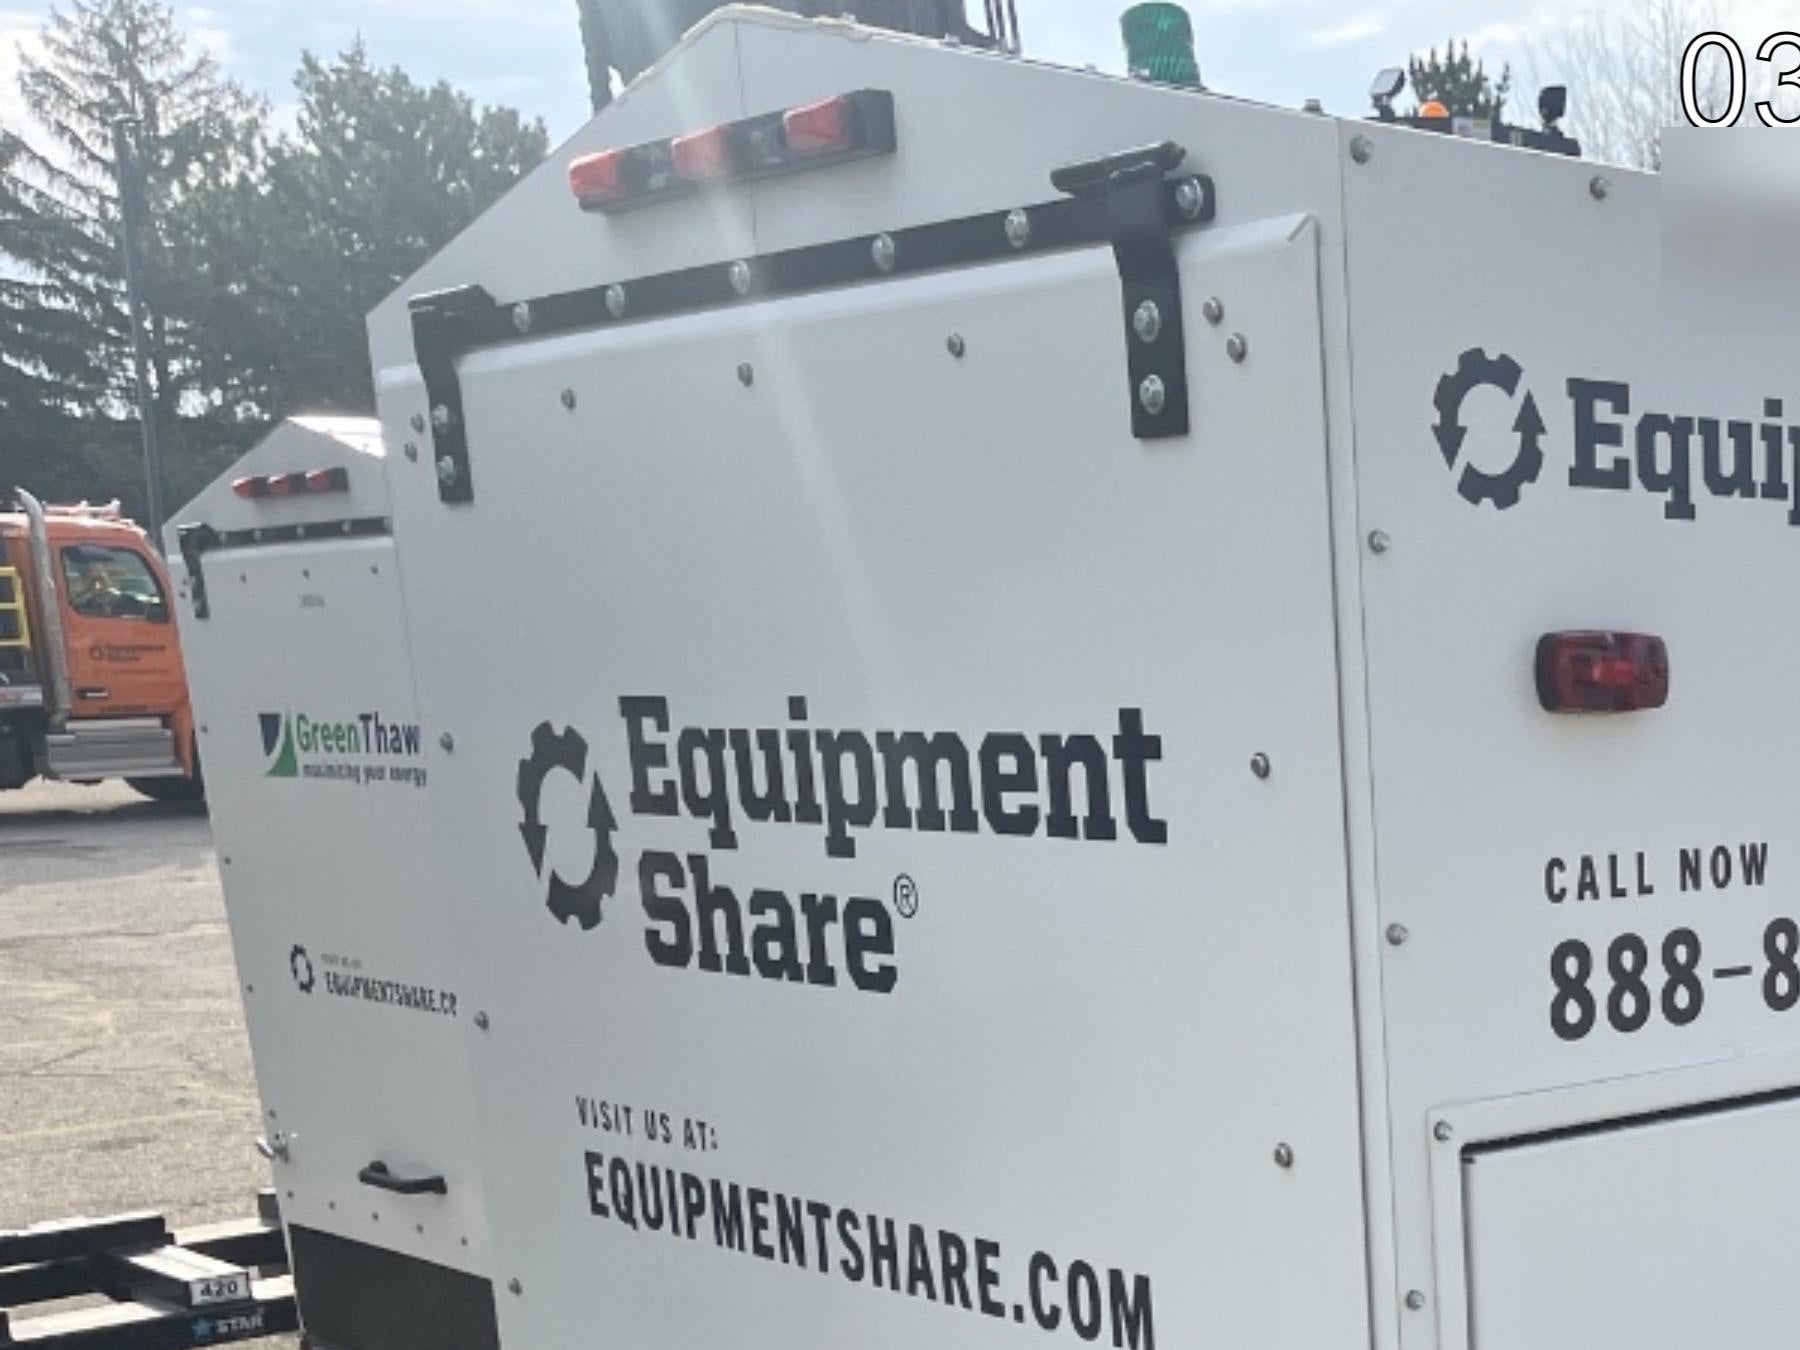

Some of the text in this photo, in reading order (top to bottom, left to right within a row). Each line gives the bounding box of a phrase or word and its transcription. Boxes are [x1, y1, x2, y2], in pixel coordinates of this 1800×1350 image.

[617, 695, 1169, 859] Equipment
[1544, 842, 1769, 903] CALL NOW
[575, 1096, 719, 1151] VISIT US AT:
[200, 1280, 238, 1298] 420
